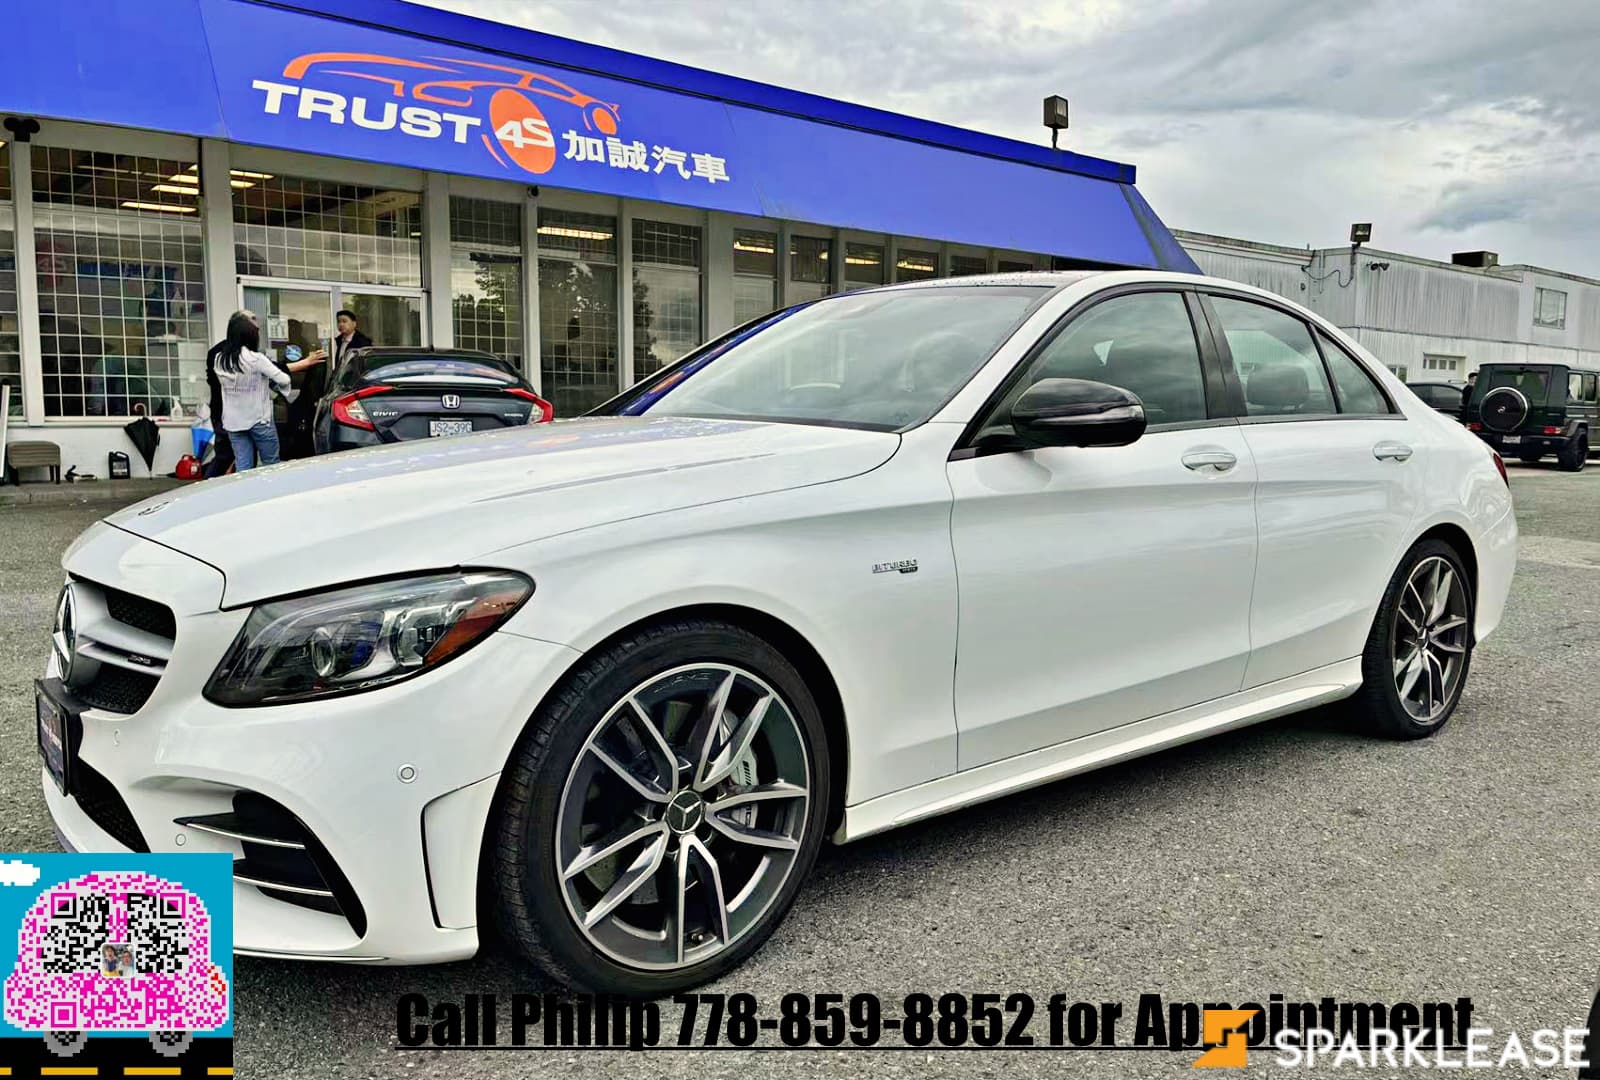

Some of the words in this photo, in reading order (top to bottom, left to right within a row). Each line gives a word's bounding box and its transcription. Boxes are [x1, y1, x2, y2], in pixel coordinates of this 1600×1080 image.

[252, 79, 482, 144] TRUST
[496, 117, 554, 149] 4S
[562, 129, 730, 184] 加誠汽車
